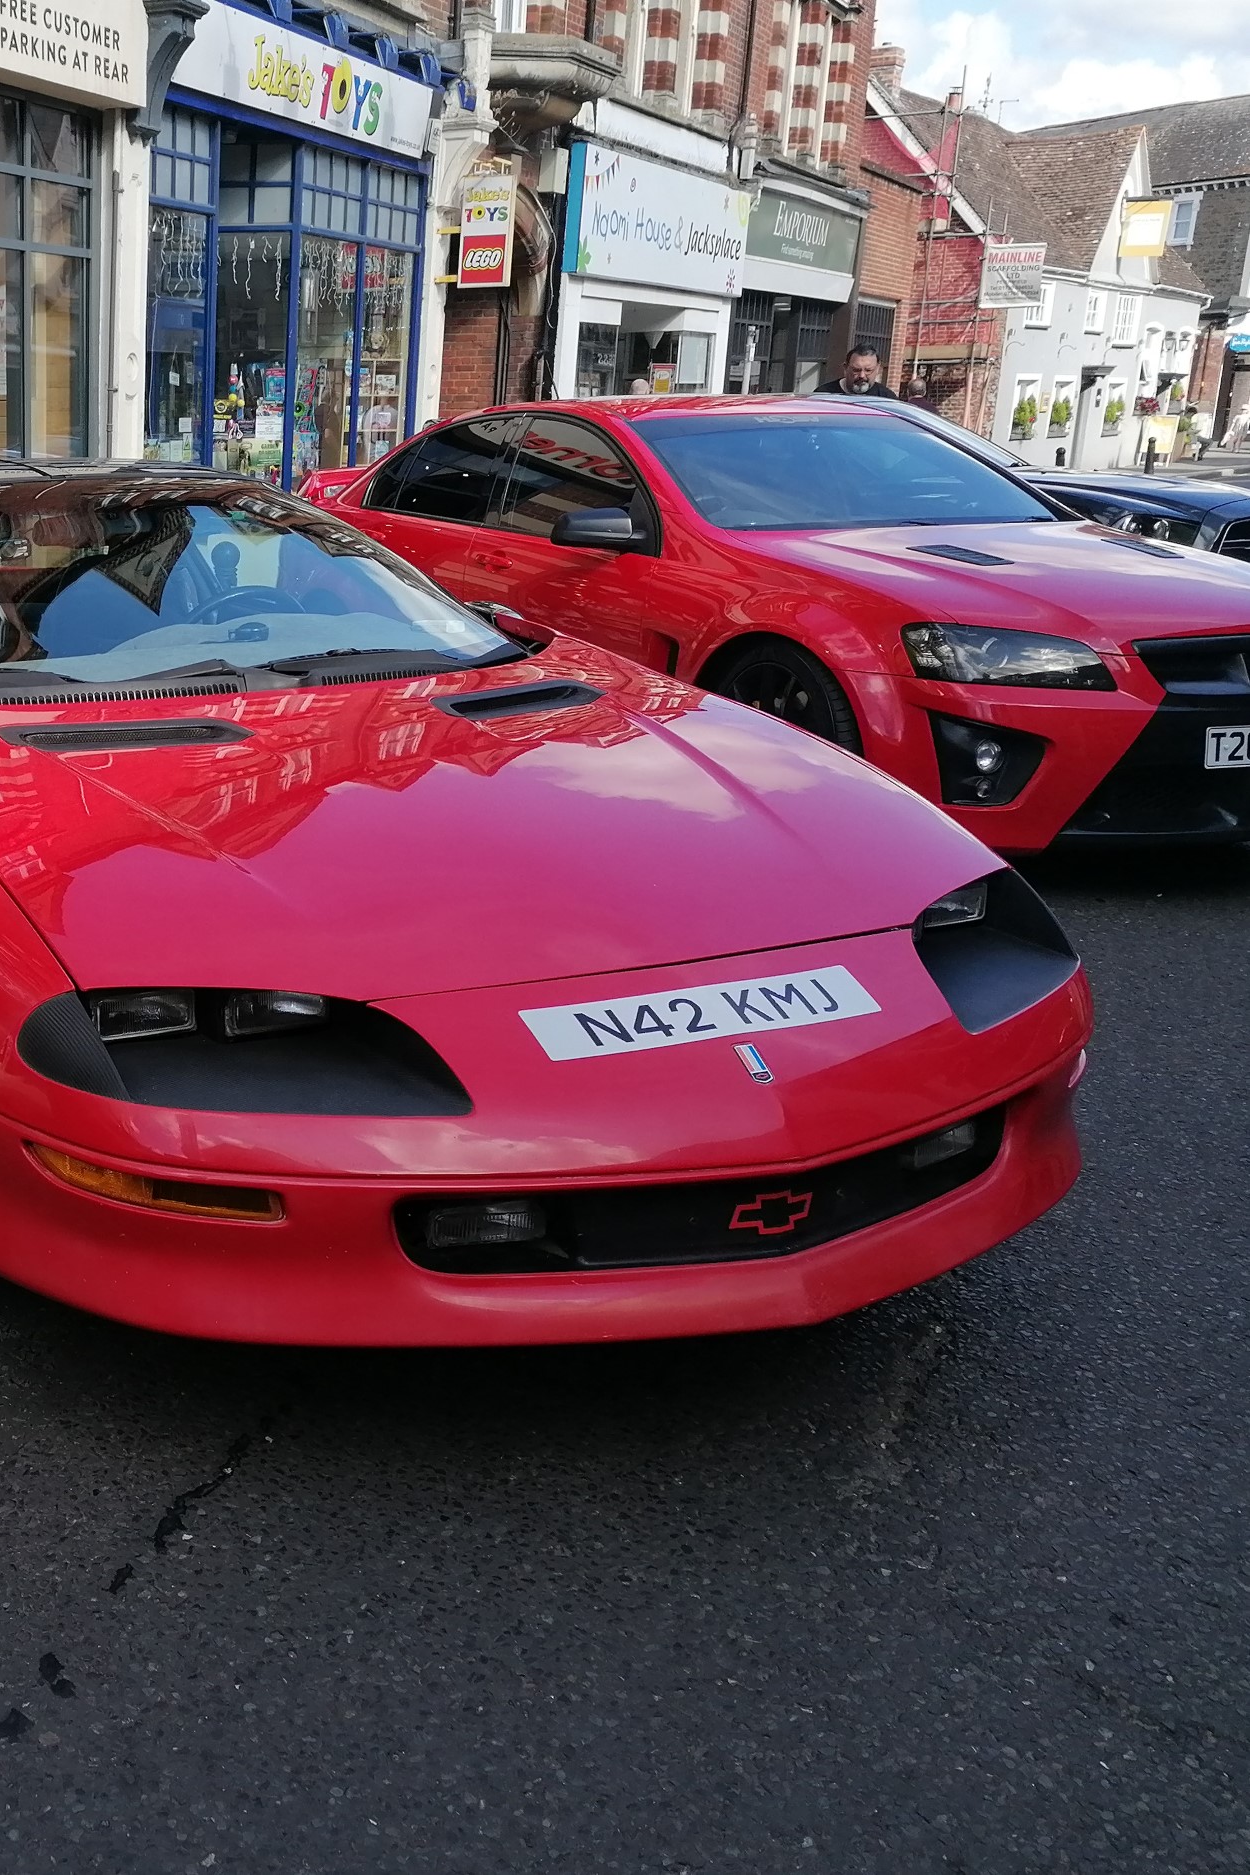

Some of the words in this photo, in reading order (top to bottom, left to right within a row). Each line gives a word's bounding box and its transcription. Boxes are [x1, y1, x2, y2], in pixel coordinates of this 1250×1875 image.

[0, 0, 38, 26] FREE
[43, 8, 121, 52] CUSTOMER
[0, 26, 68, 67] PARKING
[72, 49, 89, 73] AT
[94, 55, 129, 85] REAR
[247, 33, 315, 109] Jake's
[320, 55, 383, 136] TOYS
[465, 186, 510, 203] Jake's
[465, 205, 509, 223] TOYS
[591, 200, 630, 242] Naomi
[634, 206, 672, 250] House
[673, 215, 684, 253] &
[684, 222, 742, 263] Jacksplace
[773, 200, 830, 247] EMPORIUM
[463, 248, 504, 270] LEGO
[987, 251, 1043, 264] MAINLINE
[1211, 731, 1250, 763] T2
[573, 998, 717, 1047] N42
[720, 978, 839, 1025] KMJ
